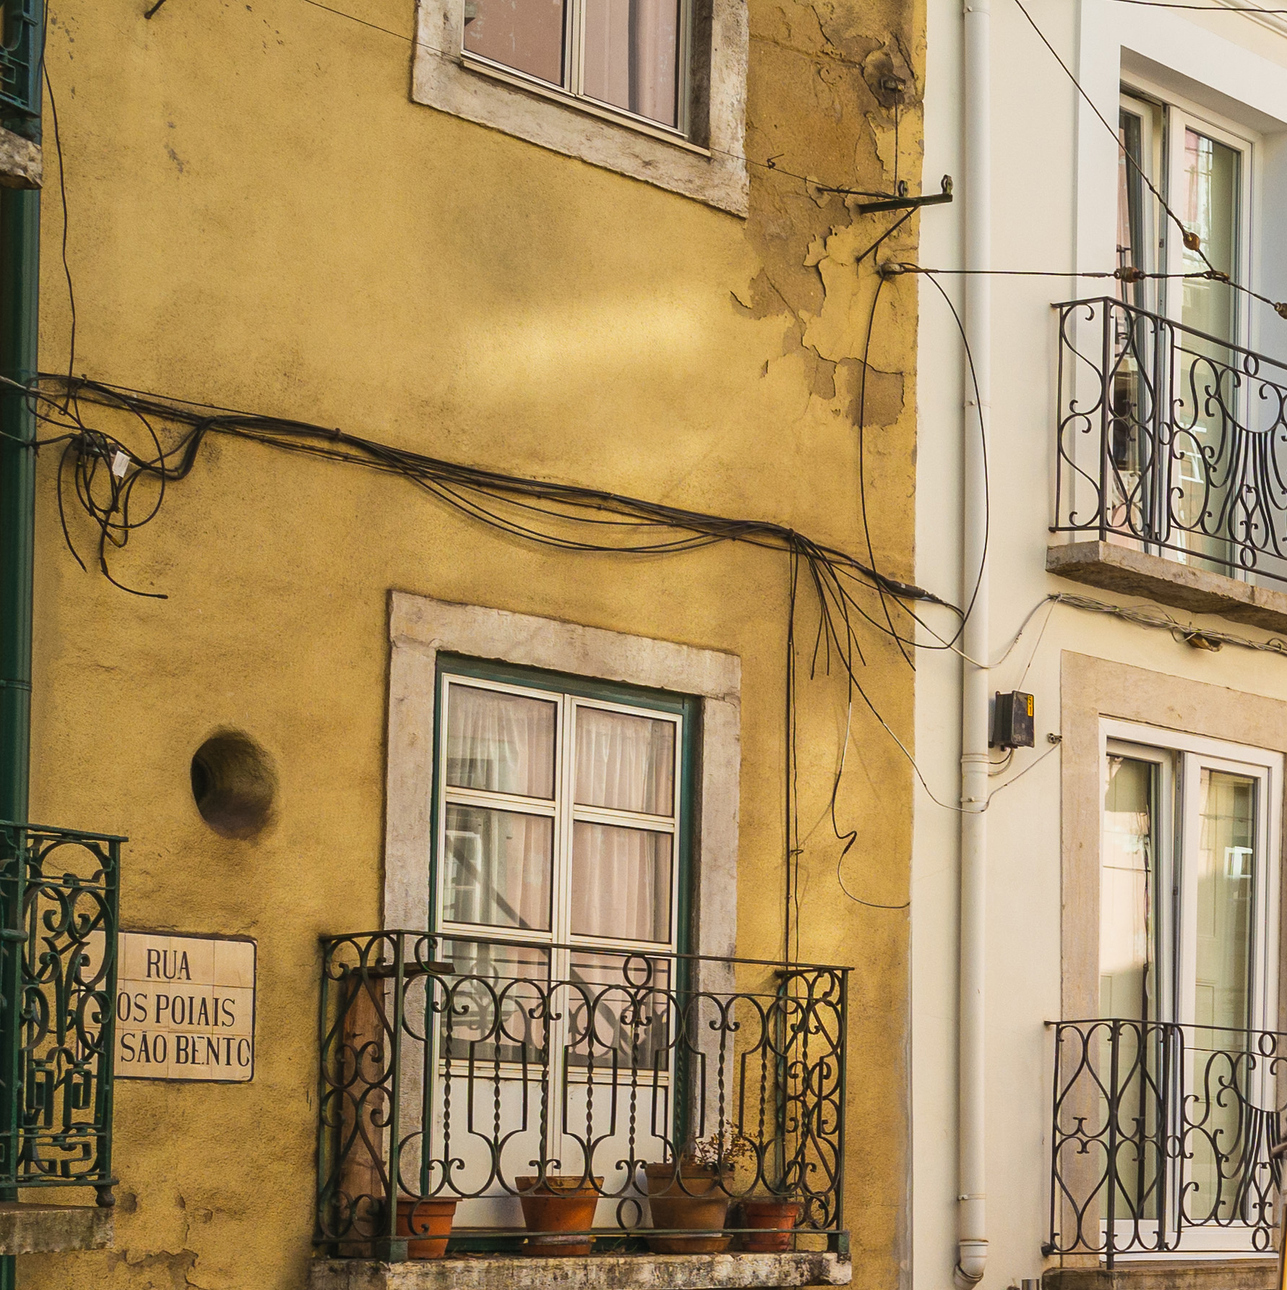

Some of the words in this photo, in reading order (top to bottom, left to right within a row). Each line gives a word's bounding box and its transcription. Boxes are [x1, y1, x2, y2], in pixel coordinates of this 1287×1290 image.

[146, 948, 191, 980] RUA
[117, 991, 148, 1023] OS
[155, 994, 236, 1027] POIAIS
[121, 1031, 167, 1063] SÃO
[175, 1035, 250, 1067] BENTO
